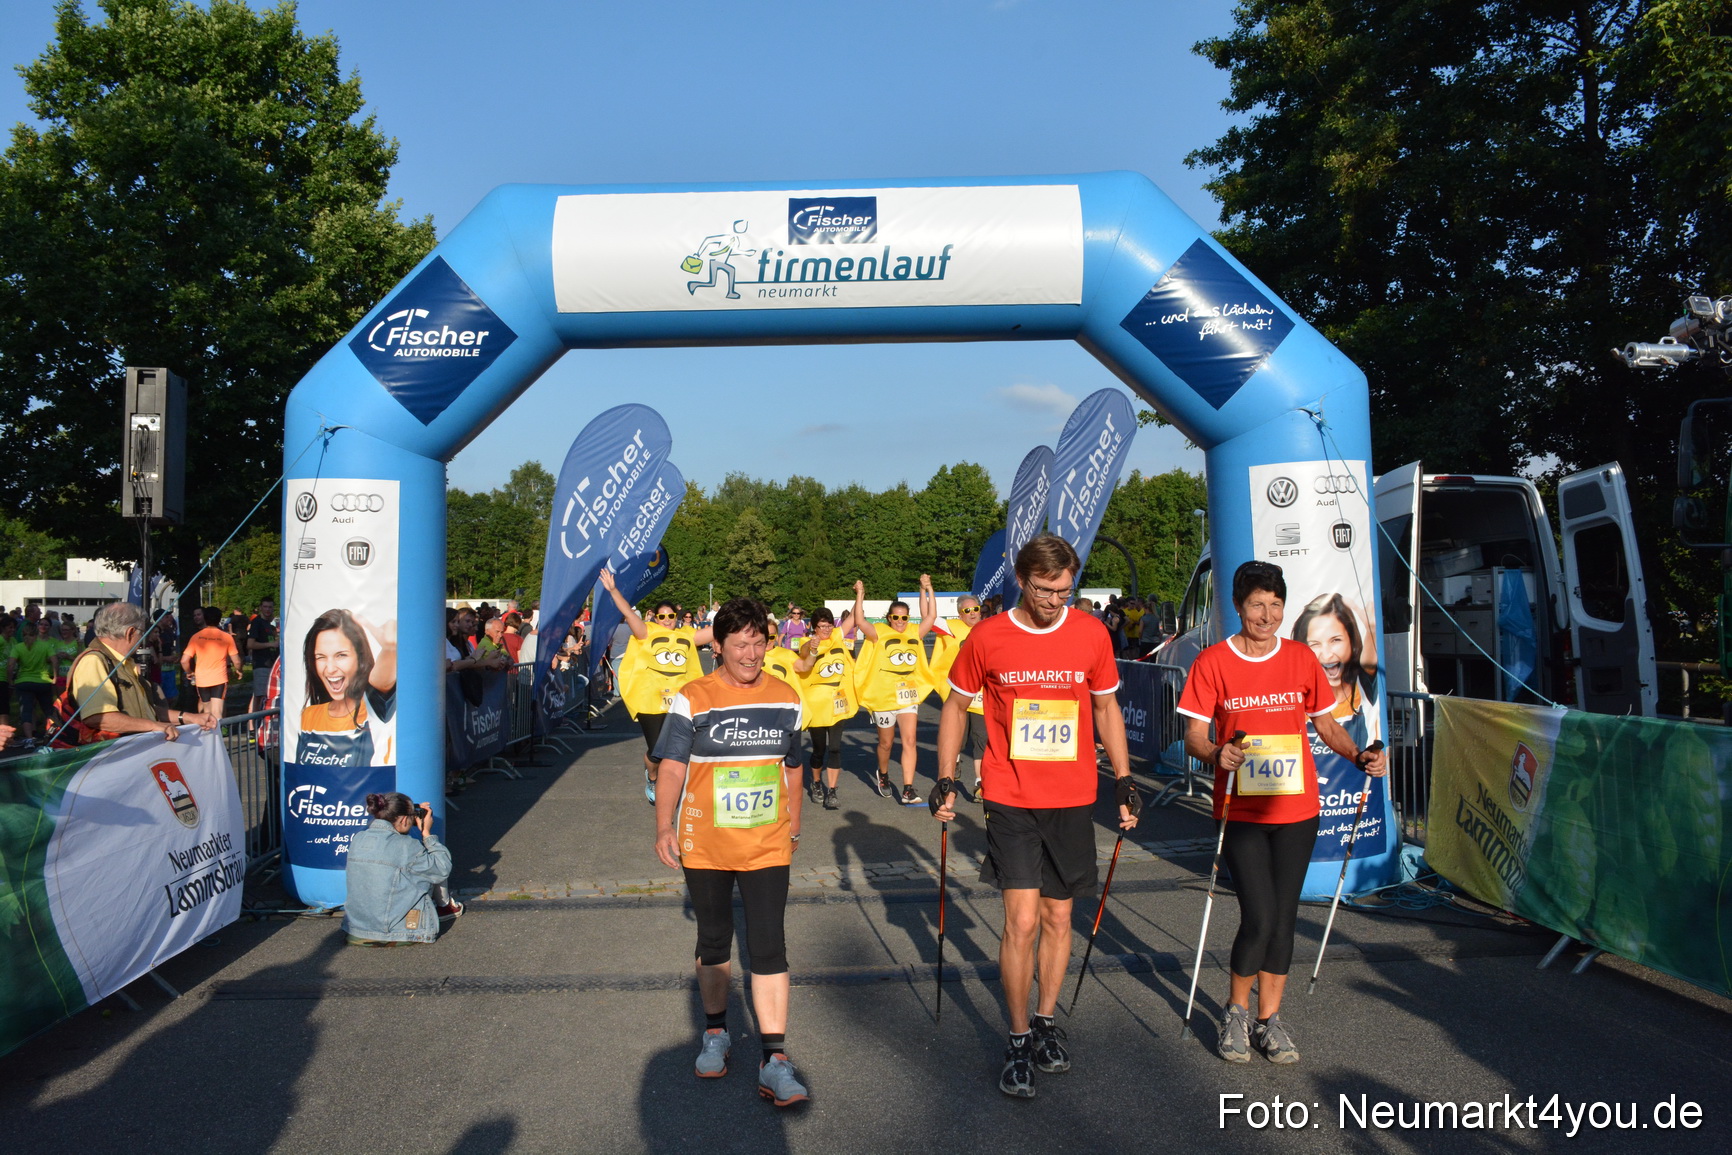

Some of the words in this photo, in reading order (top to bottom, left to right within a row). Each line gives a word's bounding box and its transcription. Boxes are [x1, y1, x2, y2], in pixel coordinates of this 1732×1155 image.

[807, 214, 872, 227] Fischer
[757, 243, 953, 283] firmenlauf
[758, 284, 838, 298] neumarkt
[1161, 308, 1189, 324] und
[1222, 302, 1274, 316] Lächeln
[1242, 318, 1273, 331] mit!
[386, 325, 490, 346] Fischer
[394, 348, 481, 357] AUTOMOBILE
[1068, 412, 1117, 532] Fischer
[1084, 431, 1122, 528] AUTOMOBILE
[576, 428, 646, 541] Fischer
[599, 448, 652, 539] AUTOMOBILE
[1316, 499, 1337, 507] Audi
[331, 516, 355, 524] Audi
[617, 477, 668, 560] Fischer
[634, 491, 672, 559] AUTOMOBILE
[1334, 528, 1351, 543] FIAT
[349, 546, 368, 561] FIAT
[1268, 548, 1310, 558] SEAT
[978, 561, 1005, 603] ischman
[999, 670, 1072, 684] NEUMARKT
[1224, 692, 1295, 711] NEUMARKT
[471, 706, 502, 736] Fischer
[880, 716, 889, 726] 24
[1122, 701, 1147, 727] cher
[724, 726, 784, 740] Fischer
[1020, 723, 1071, 744] 1419
[730, 739, 782, 747] AUTOMOBILE
[1245, 758, 1297, 778] 1407
[721, 788, 774, 812] 1675
[1318, 789, 1372, 807] scher
[1319, 805, 1368, 817] TOMOBIE
[303, 817, 368, 826] AUTOMOBILE
[1337, 823, 1353, 832] das
[1357, 818, 1381, 829] ächeln
[314, 834, 331, 844] und
[332, 833, 349, 843] das
[168, 832, 233, 875] Neumarkter
[164, 854, 244, 918] Lammsbräu
